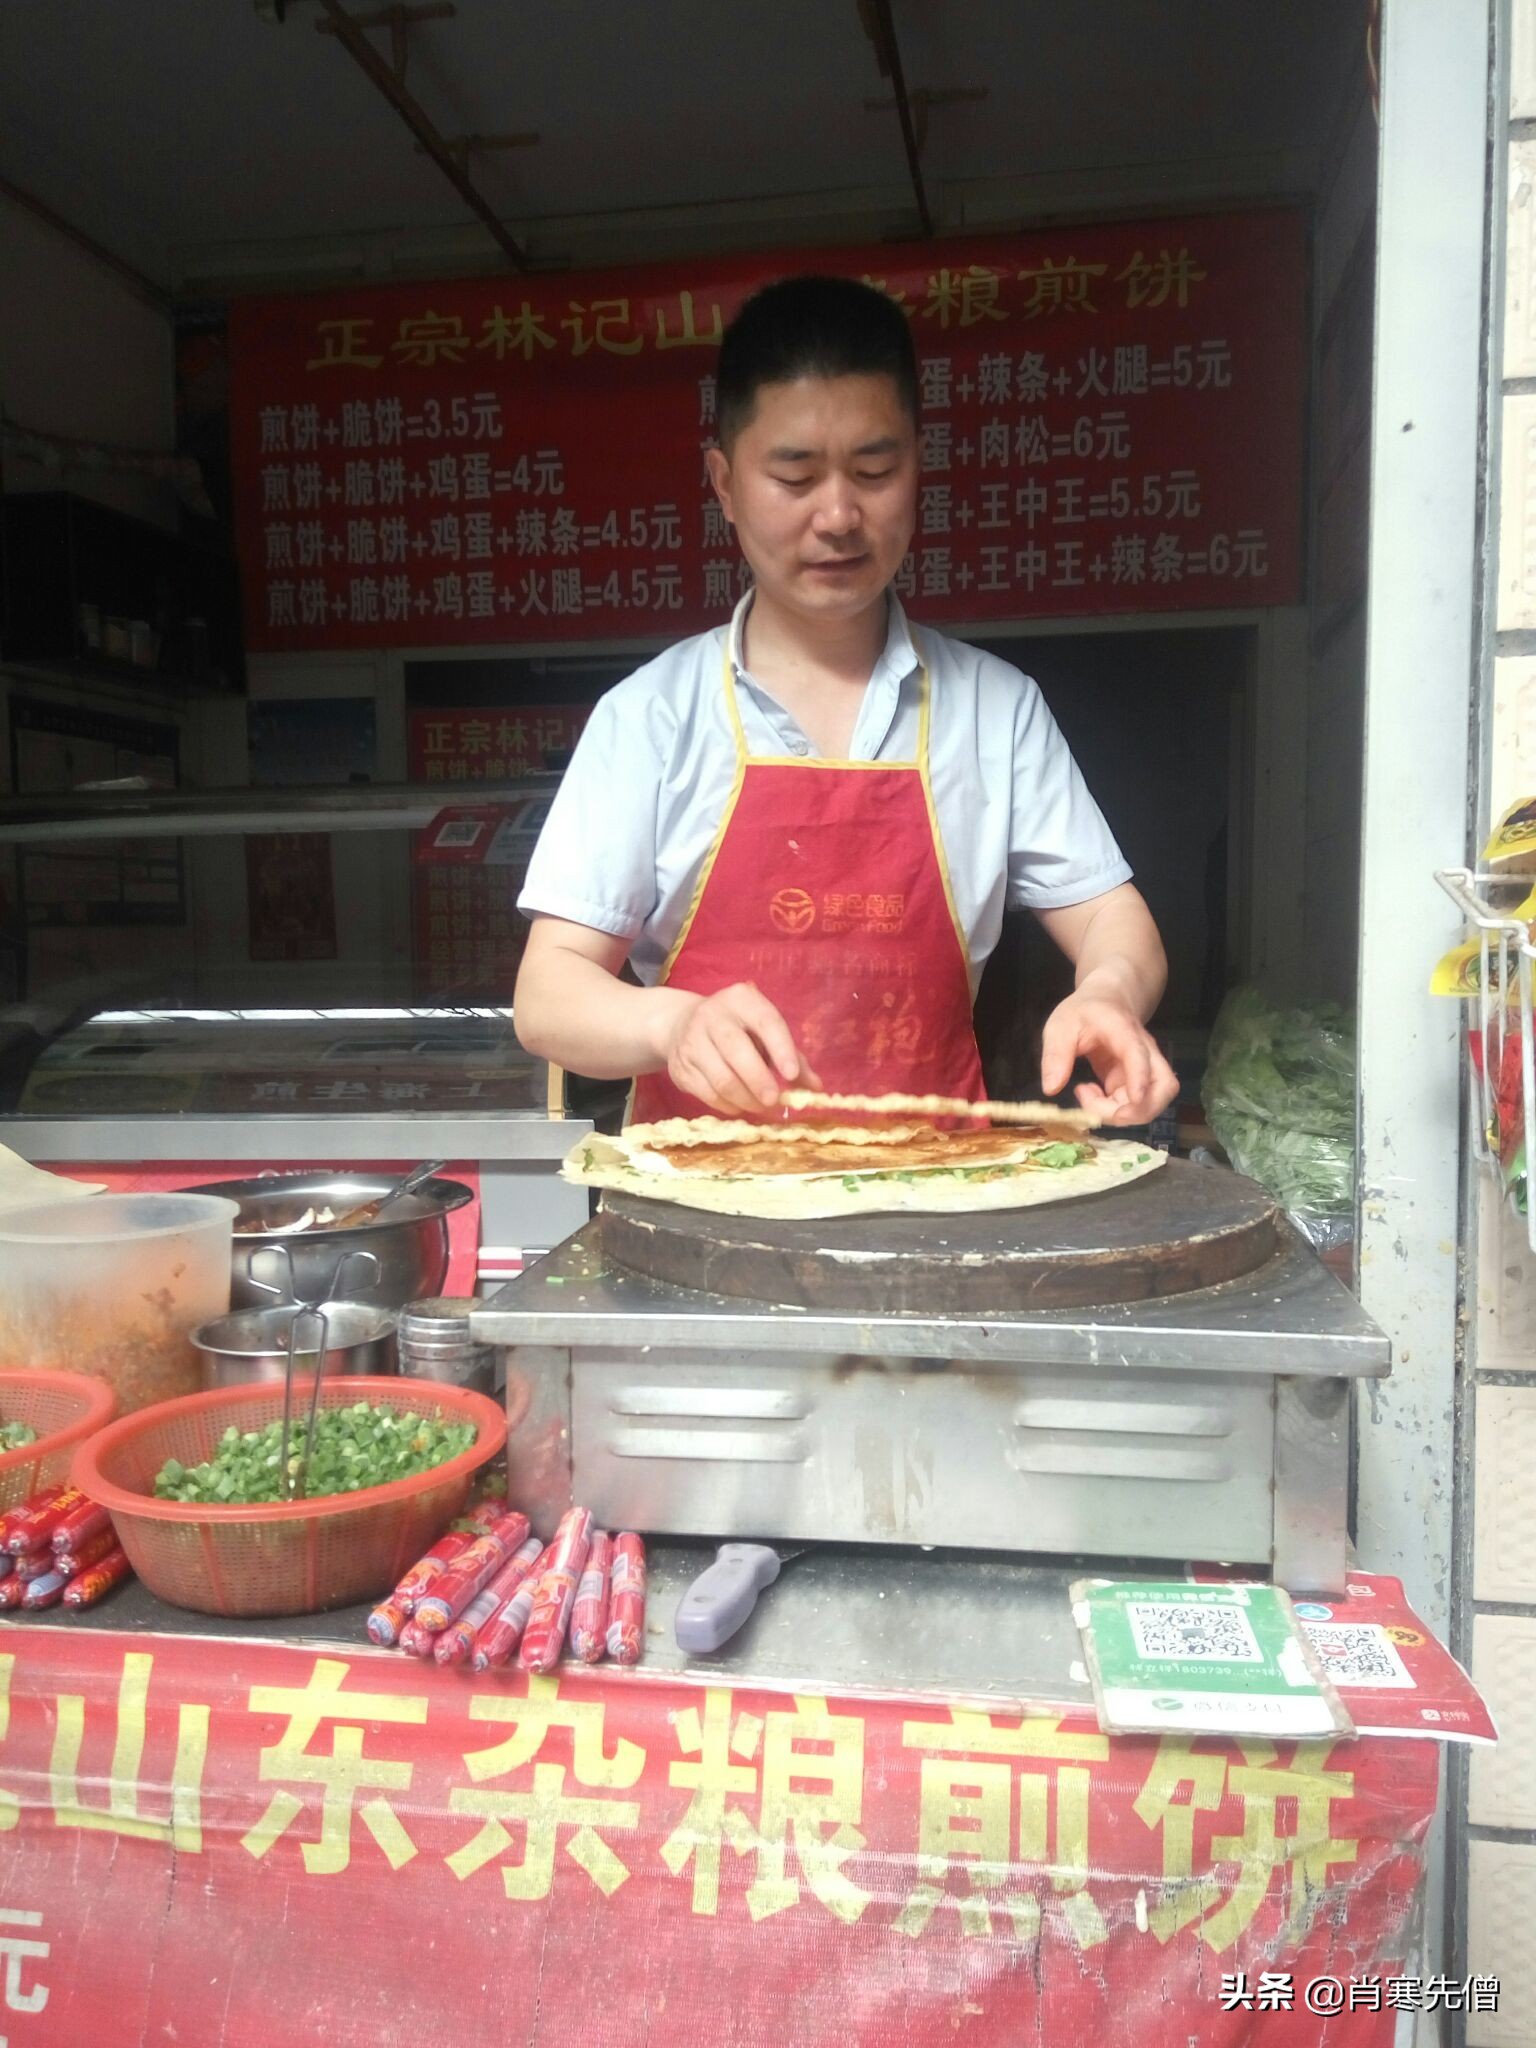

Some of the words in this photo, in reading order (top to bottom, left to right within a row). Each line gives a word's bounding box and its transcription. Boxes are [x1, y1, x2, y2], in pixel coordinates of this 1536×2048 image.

[258, 392, 504, 454] 煎饼+脆饼=3.5元
[261, 449, 565, 511] 煎饼+脆饼+鸡蛋=4元
